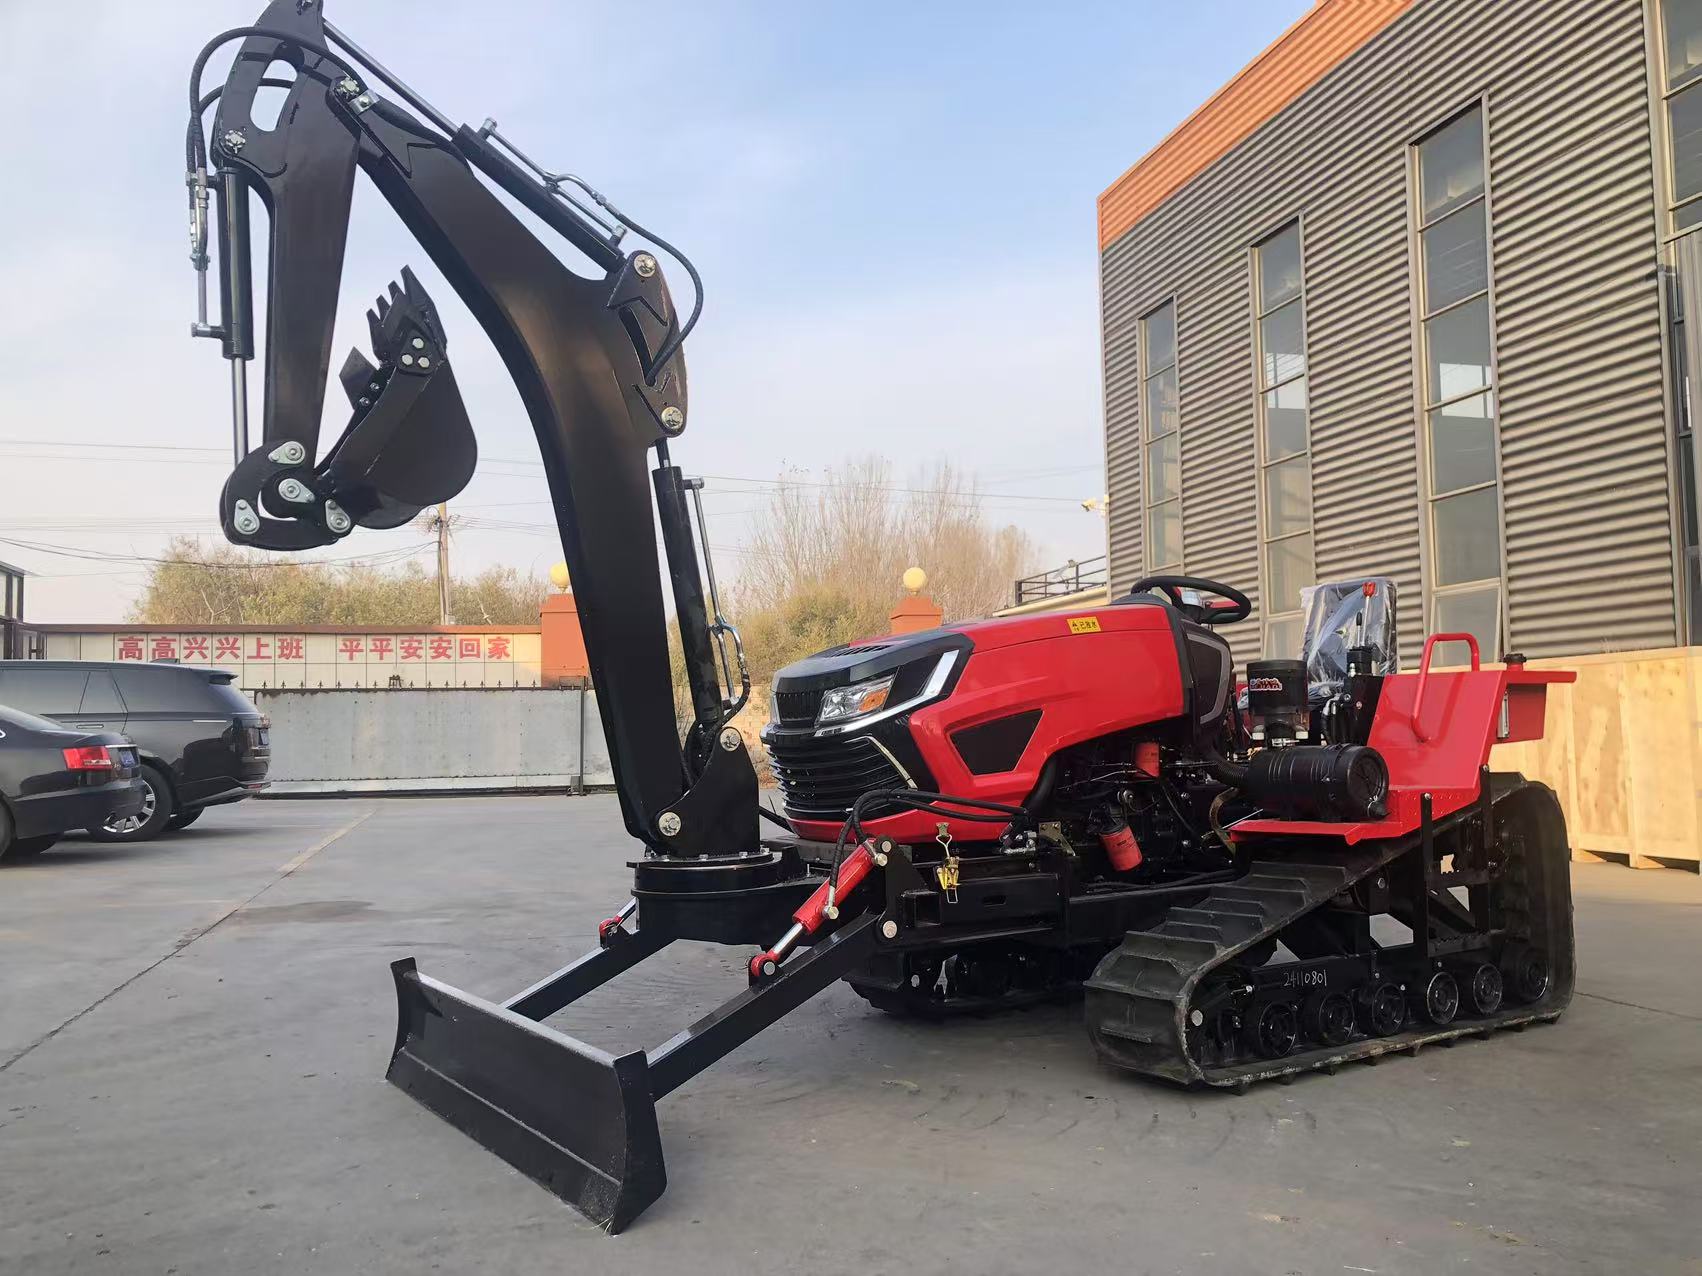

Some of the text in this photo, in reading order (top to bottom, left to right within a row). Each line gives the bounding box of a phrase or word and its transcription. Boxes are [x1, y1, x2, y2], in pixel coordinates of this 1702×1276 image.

[117, 636, 511, 660] 高高兴兴上班 平平安安回家
[1283, 969, 1327, 987] 24110801
